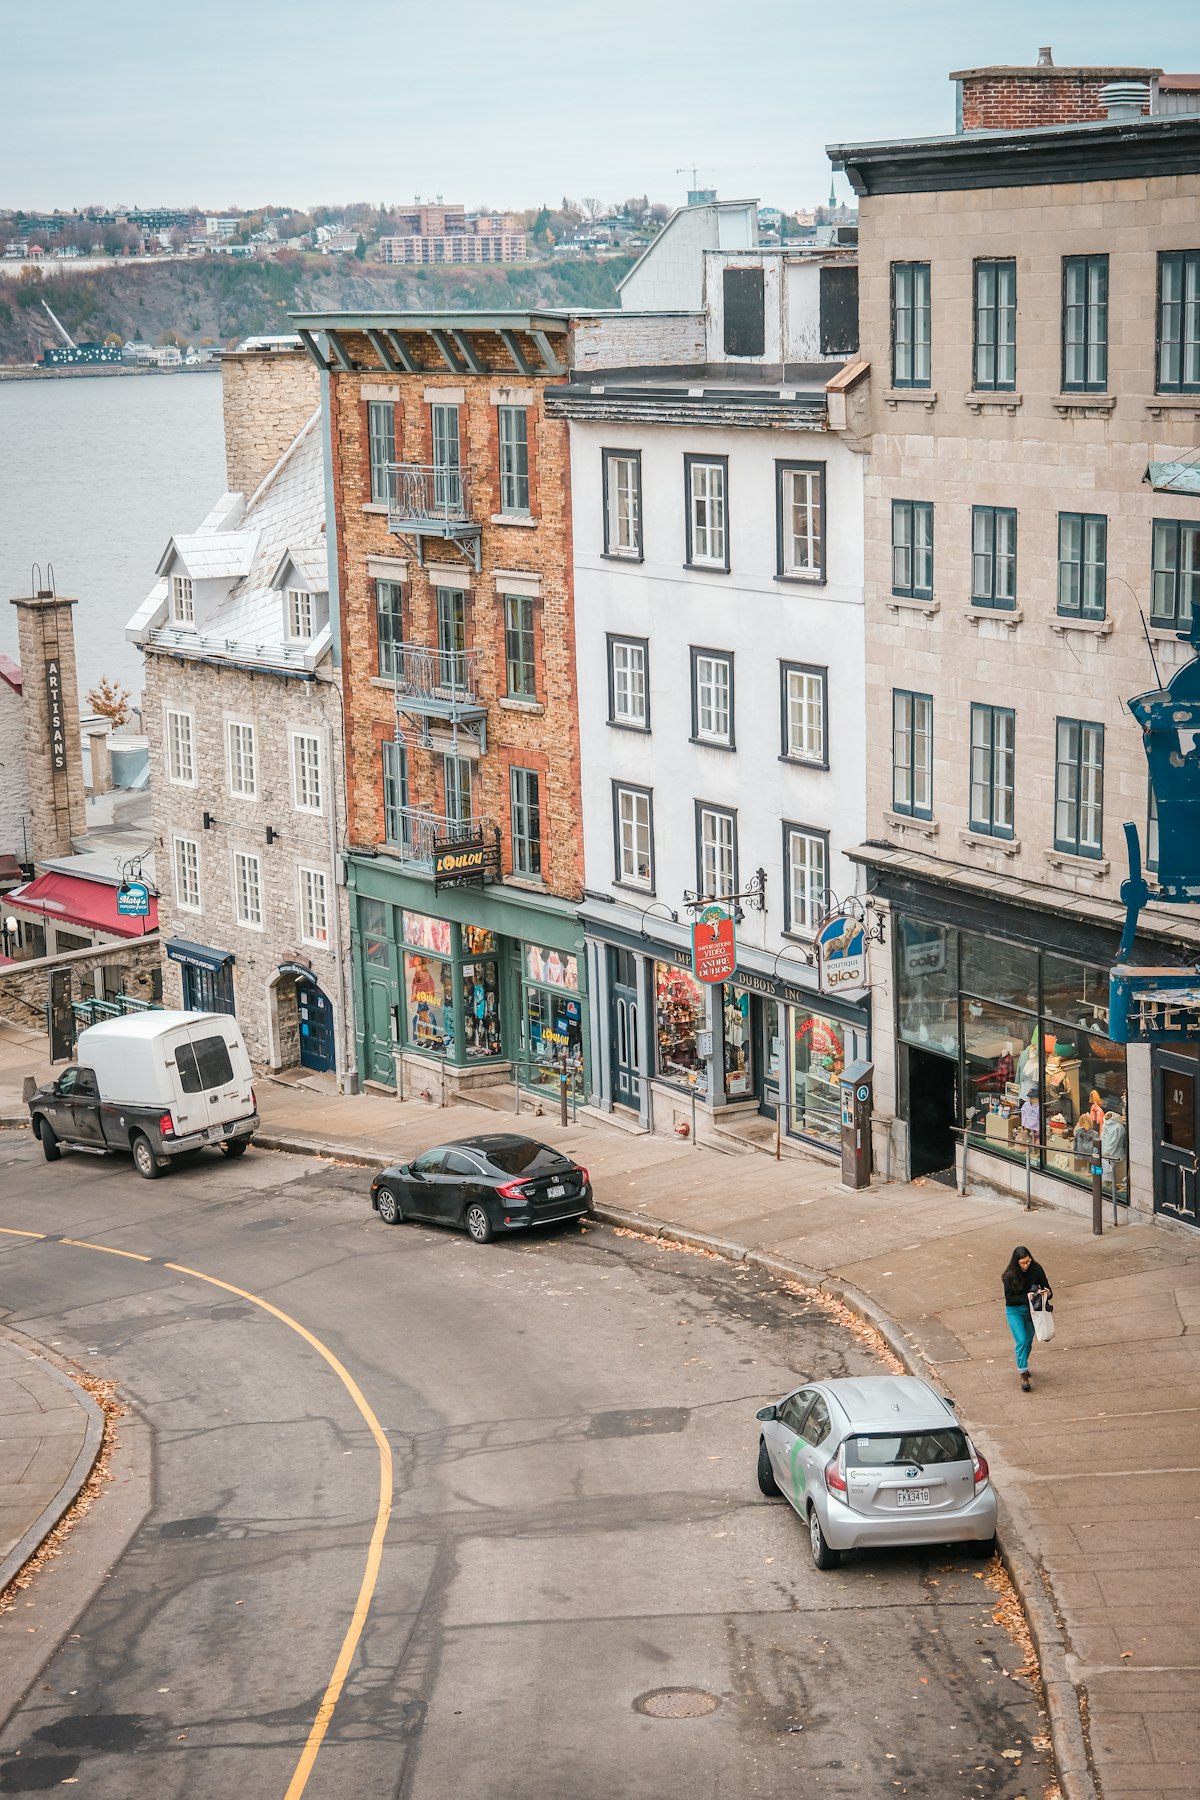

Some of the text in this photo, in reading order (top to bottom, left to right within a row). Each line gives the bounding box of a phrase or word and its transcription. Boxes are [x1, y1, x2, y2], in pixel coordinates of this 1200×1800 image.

[49, 663, 63, 767] ARTISANS
[437, 852, 482, 871] LOULOU
[119, 896, 146, 909] Mary's
[698, 941, 731, 951] IMPORTATIONS
[699, 965, 732, 976] DUBOIS
[827, 960, 858, 969] BOUTIQUE
[739, 973, 776, 994] DUBOIS
[784, 987, 803, 1002] INC
[542, 1028, 569, 1045] LOULOU
[1173, 1089, 1184, 1105] 42
[850, 1470, 883, 1479] Communauto
